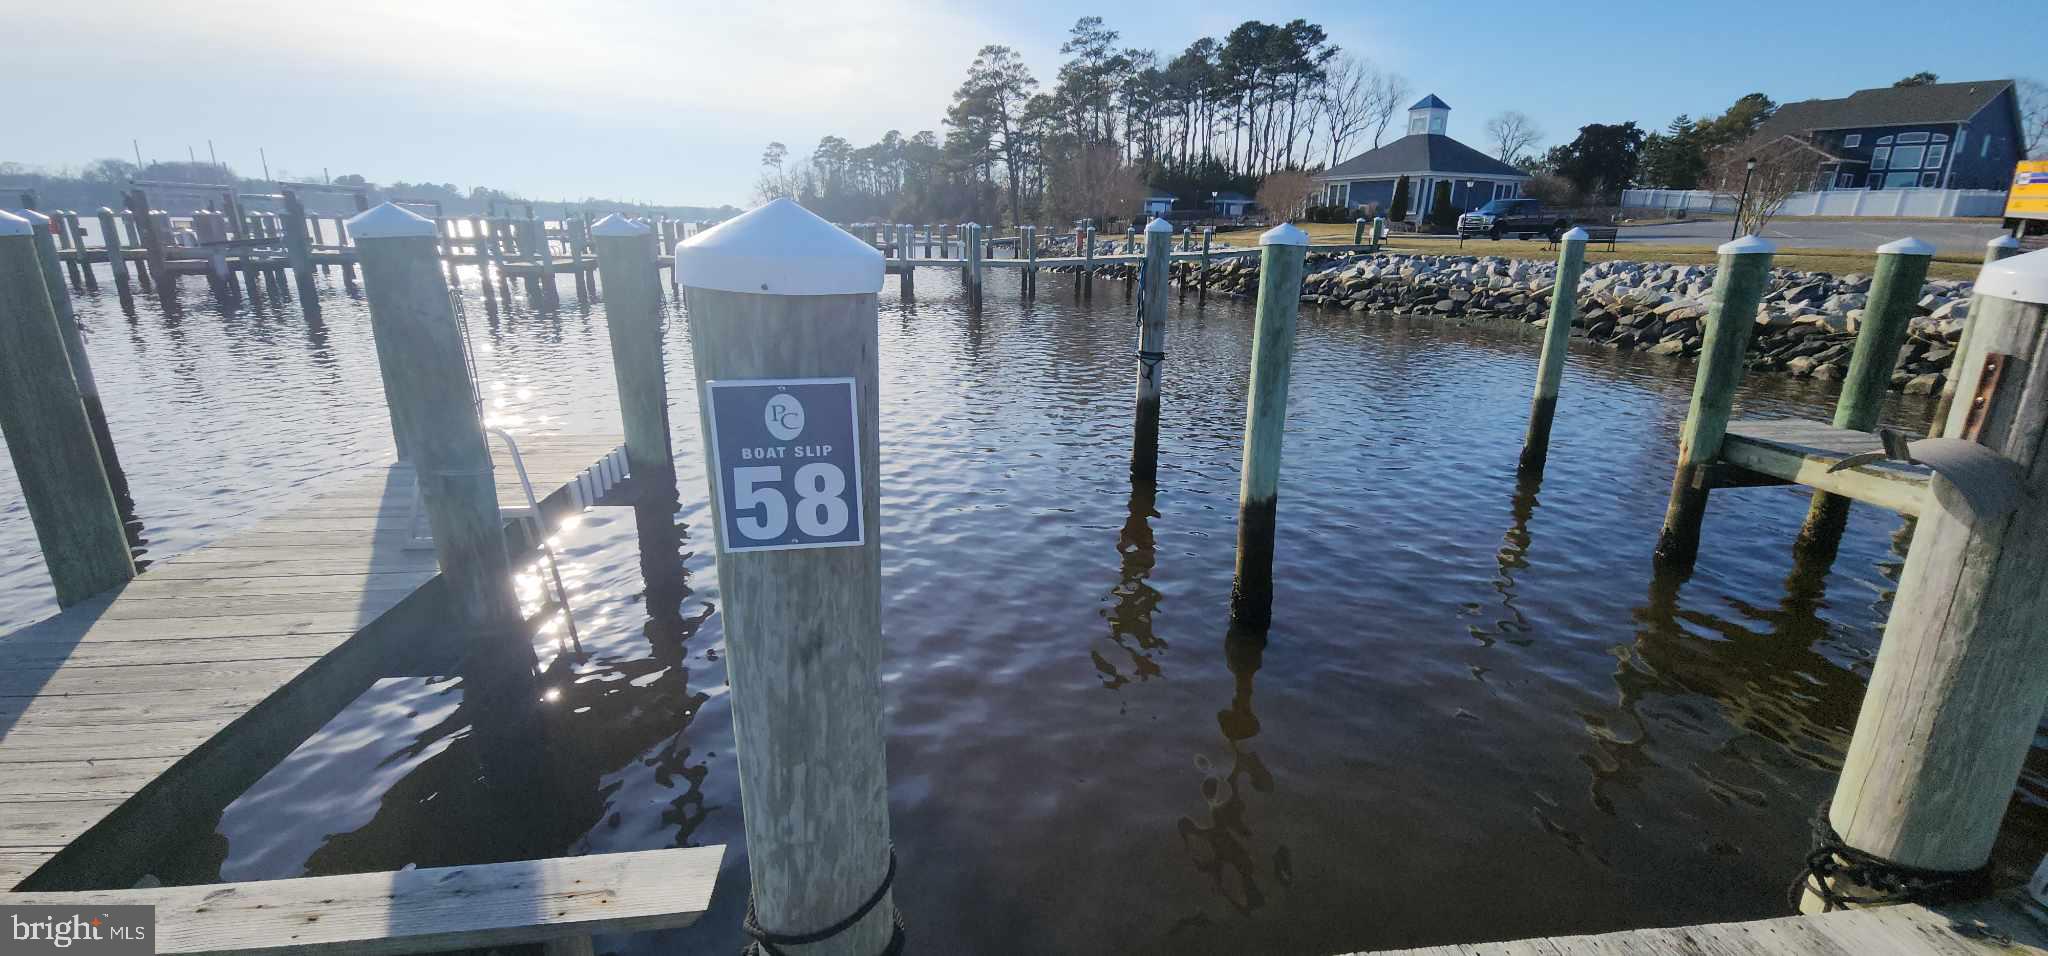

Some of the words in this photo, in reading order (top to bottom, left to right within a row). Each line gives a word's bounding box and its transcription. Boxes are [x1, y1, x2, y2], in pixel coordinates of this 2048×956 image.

[771, 404, 801, 430] PC
[741, 446, 786, 460] BOAT
[794, 444, 833, 457] SLIP
[733, 462, 849, 541] 58
